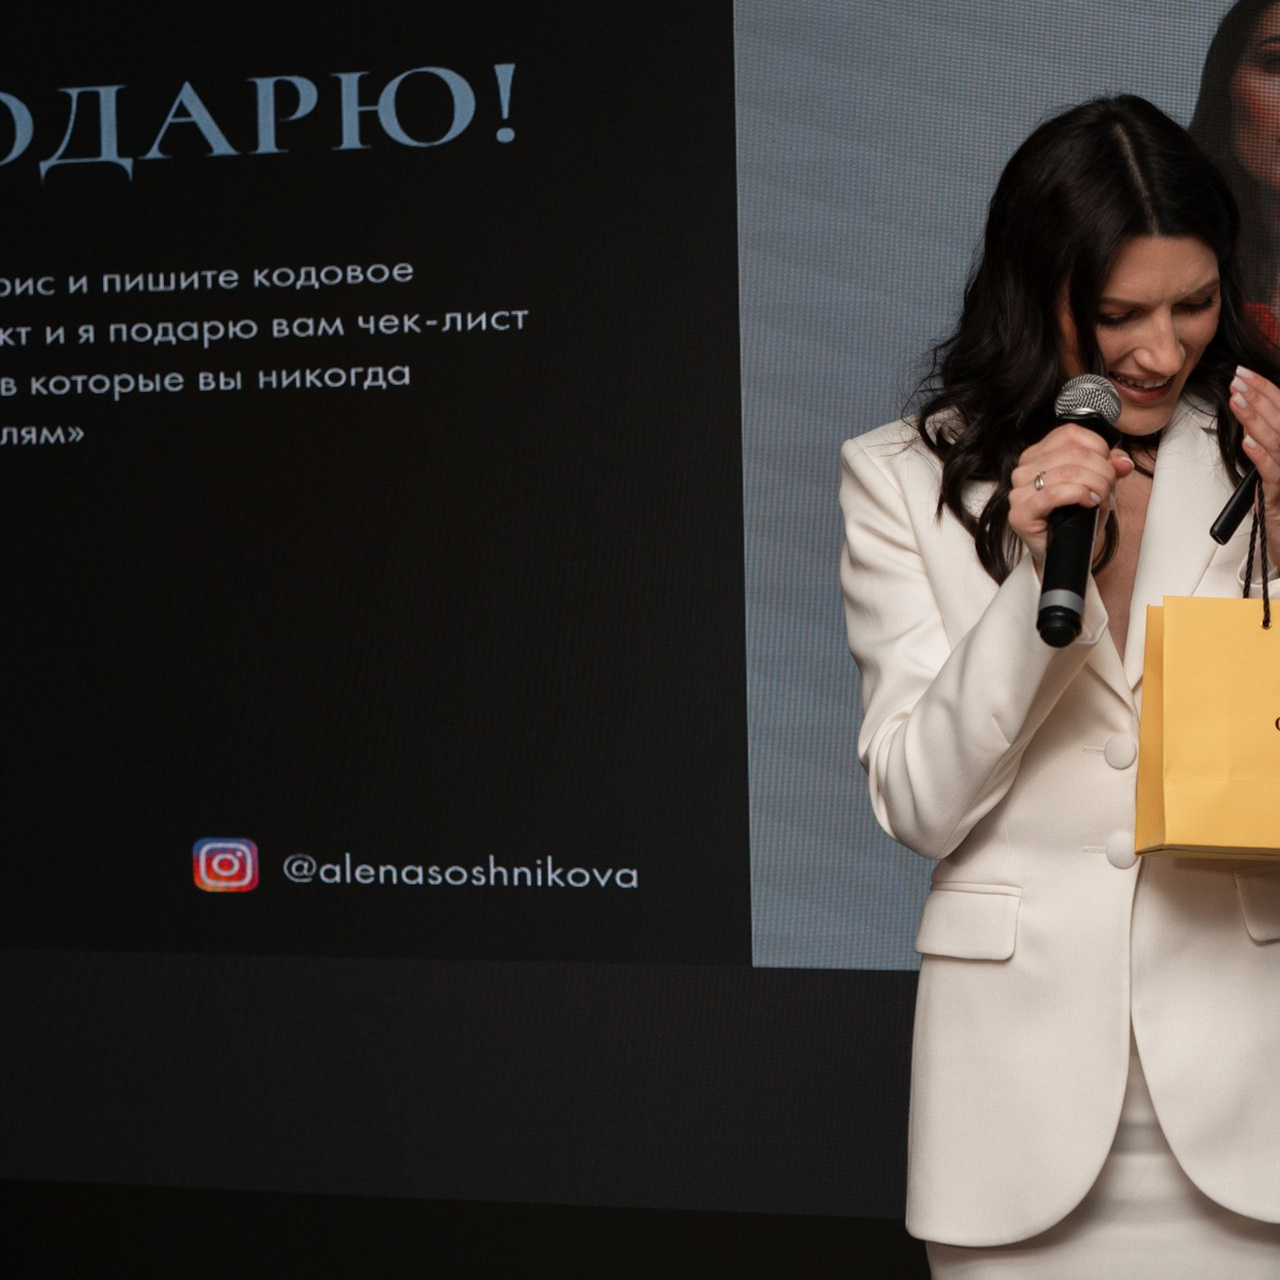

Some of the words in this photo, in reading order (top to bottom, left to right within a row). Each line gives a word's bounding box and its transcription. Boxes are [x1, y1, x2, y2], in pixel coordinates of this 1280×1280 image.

[68, 275, 88, 294] и
[102, 268, 239, 293] пишите
[253, 262, 414, 290] кодовое
[45, 325, 65, 345] и
[78, 324, 95, 344] я
[109, 318, 258, 349] подарю
[272, 317, 345, 338] вам
[357, 309, 529, 335] чек-лист
[31, 371, 185, 402] которые
[198, 371, 242, 391] вы
[258, 365, 411, 390] никогда
[283, 852, 639, 889] @alenasoshnikova
